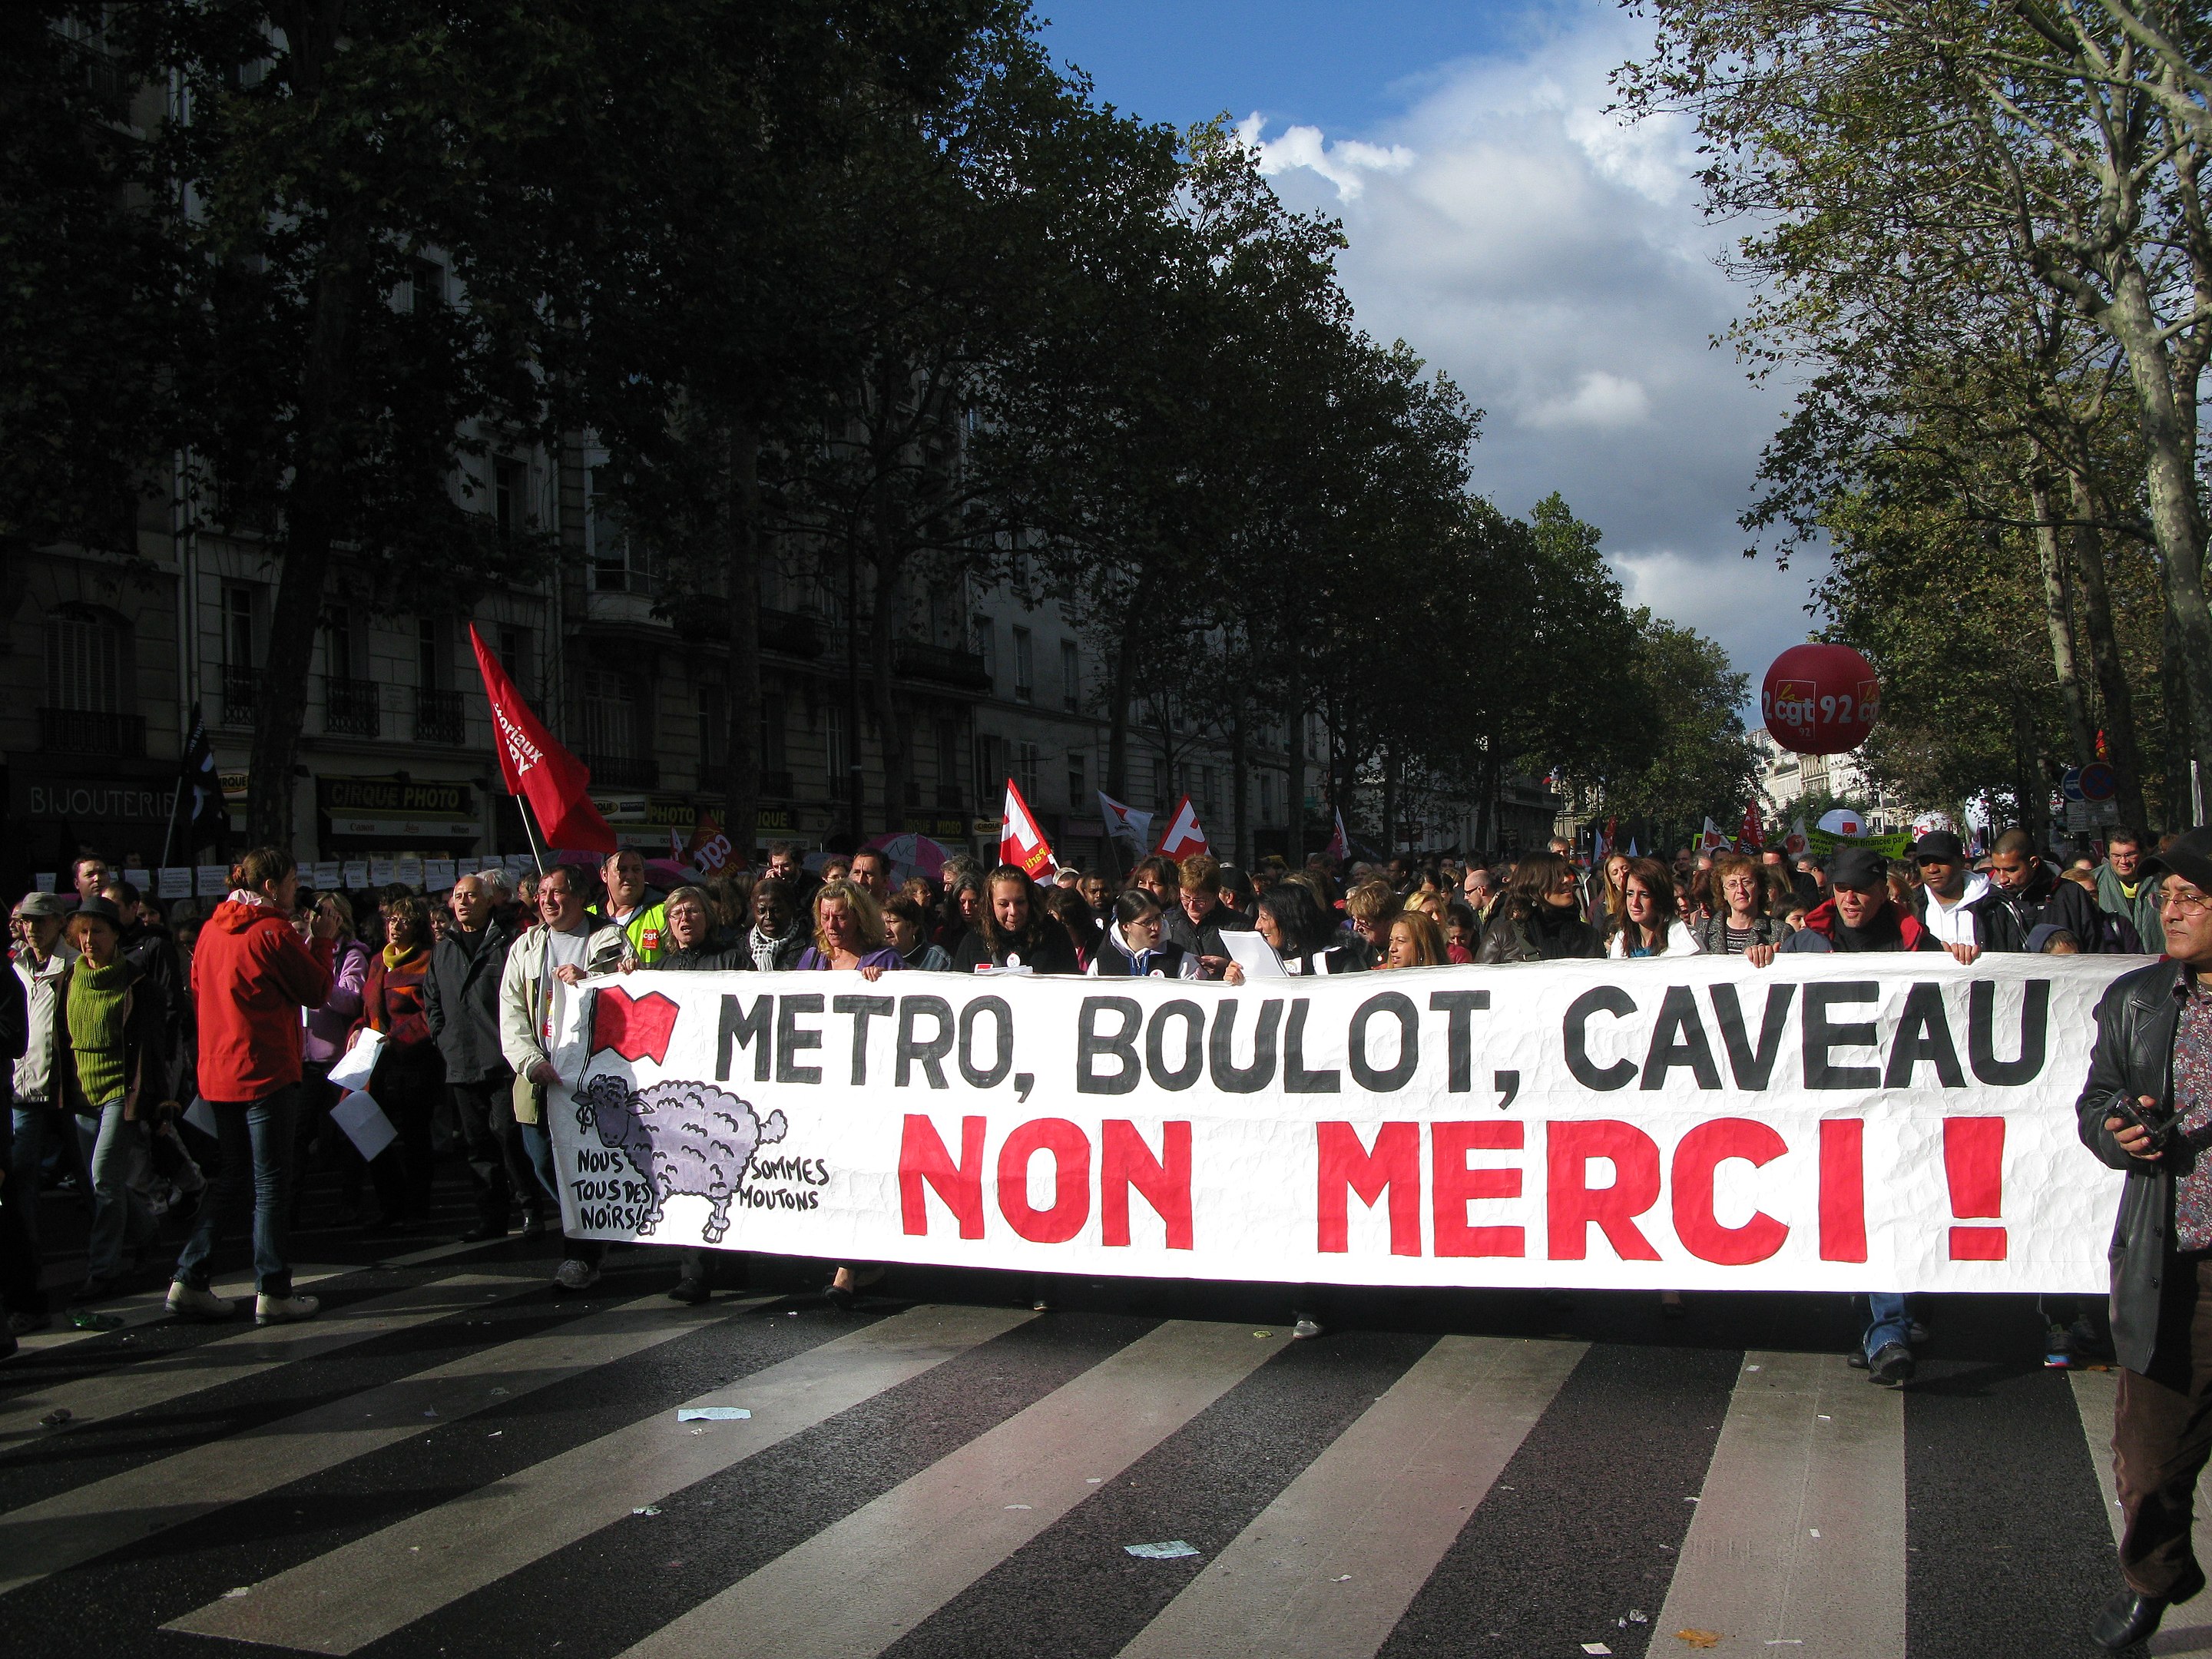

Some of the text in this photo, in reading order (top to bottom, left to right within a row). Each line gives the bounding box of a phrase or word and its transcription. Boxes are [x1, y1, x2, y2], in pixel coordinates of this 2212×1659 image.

[1775, 697, 1814, 727] cgt
[1820, 694, 1853, 724] 92
[1799, 727, 1811, 737] 92
[31, 786, 177, 819] BIJOUTERIE
[332, 783, 460, 809] CIRQUE PHOTO
[651, 806, 695, 823] PHOTO
[937, 820, 962, 834] VIDEO
[350, 823, 375, 832] Canon
[451, 824, 470, 834] Nikon
[1892, 836, 1904, 846] par
[643, 932, 657, 941] cgt
[716, 979, 2051, 1111] METRO, BOULOT, CAVEAU
[577, 1149, 624, 1174] NOUS
[750, 1155, 830, 1185] SOMMES
[571, 1179, 651, 1204] TOUS DES
[740, 1184, 820, 1211] MOUTONS
[899, 1114, 2008, 1267] NON MERCI !
